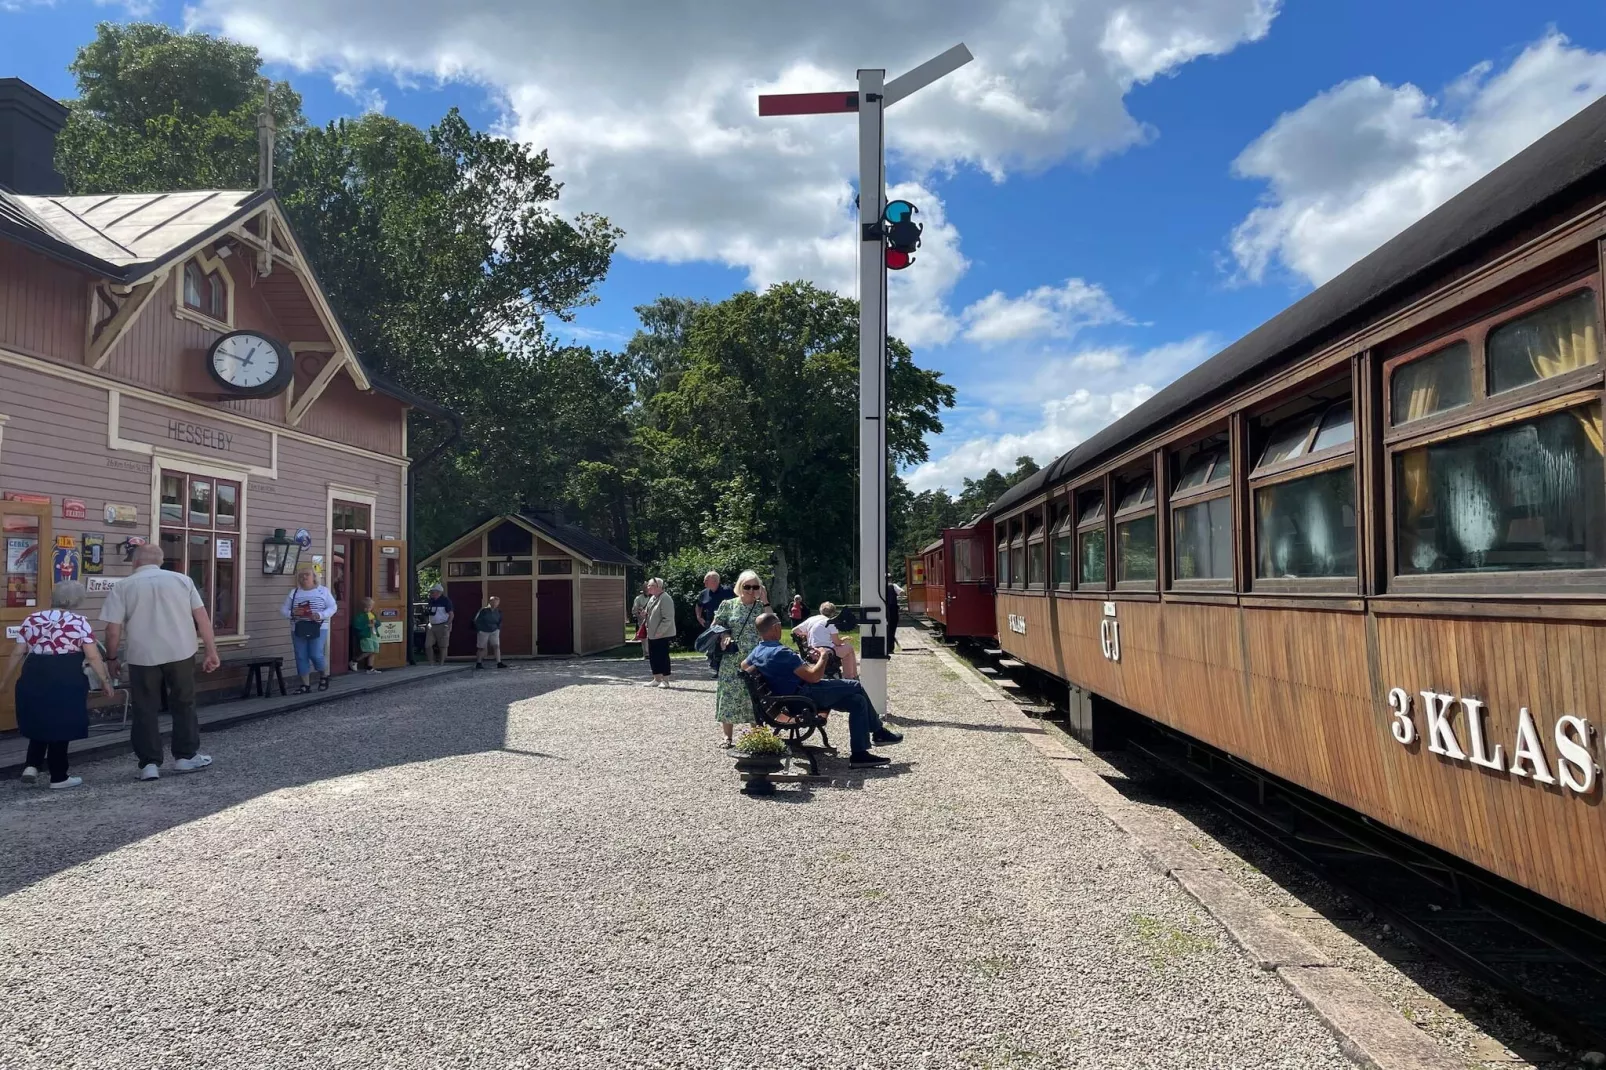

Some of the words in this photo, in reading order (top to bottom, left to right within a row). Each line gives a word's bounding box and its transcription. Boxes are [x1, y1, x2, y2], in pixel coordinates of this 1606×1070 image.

[168, 420, 233, 451] HESSELBY
[1101, 619, 1119, 660] GJ
[1388, 687, 1415, 745] 3
[1420, 690, 1606, 793] KLAS
